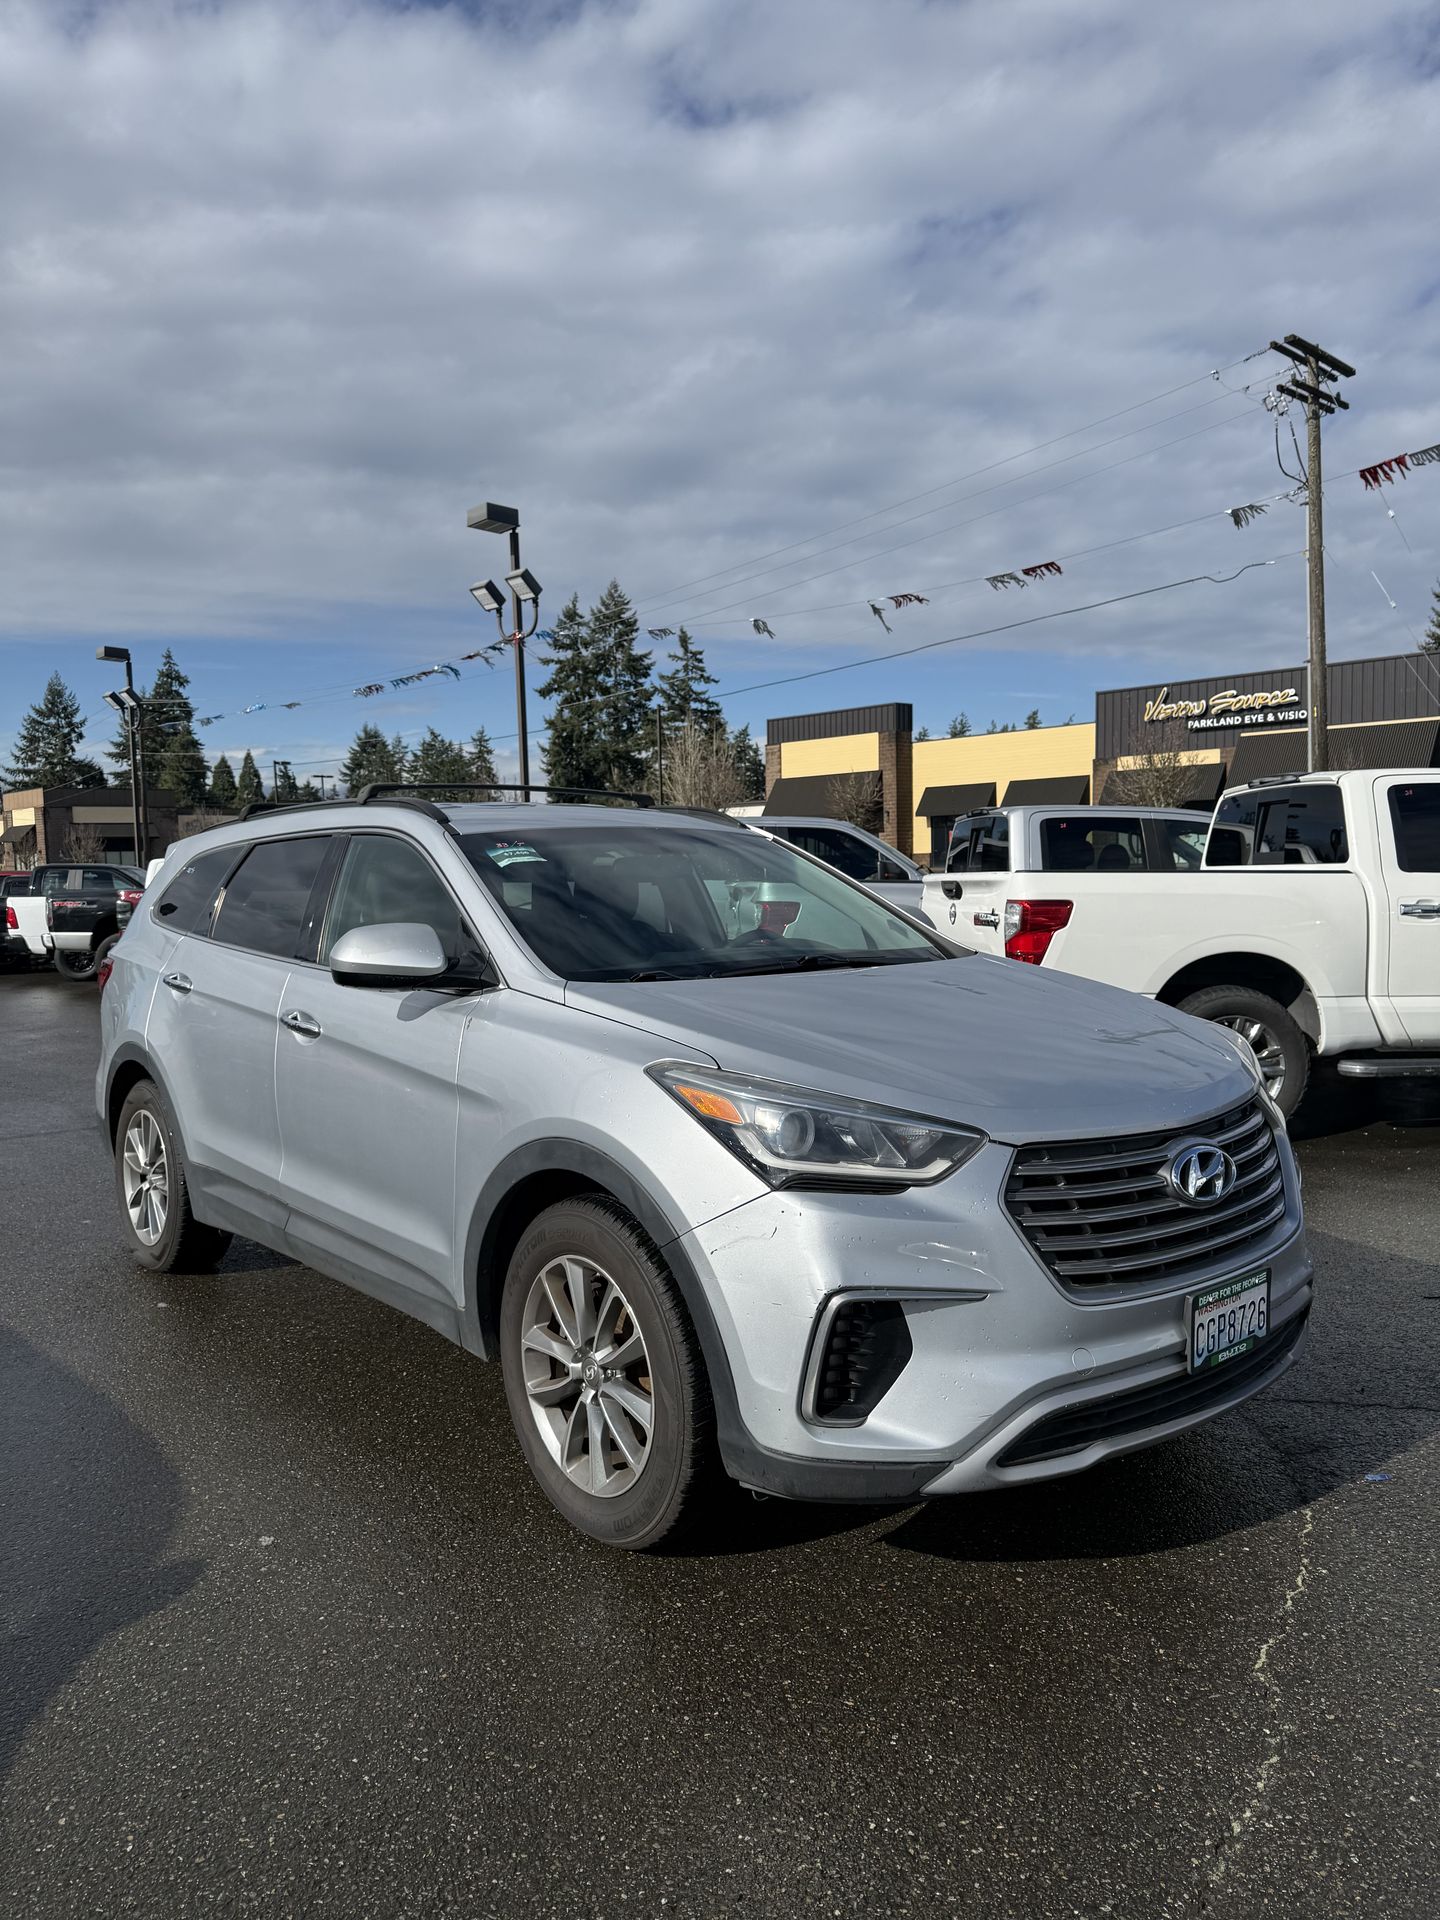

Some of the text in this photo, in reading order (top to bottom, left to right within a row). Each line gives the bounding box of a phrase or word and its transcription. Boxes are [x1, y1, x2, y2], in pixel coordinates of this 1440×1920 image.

[1188, 710, 1308, 729] PARKLAND EYE & VISIO
[1219, 1287, 1232, 1298] FOR
[1231, 1282, 1242, 1293] THE
[1199, 1293, 1242, 1317] WASHINGTON
[1196, 1296, 1266, 1358] CGP8726
